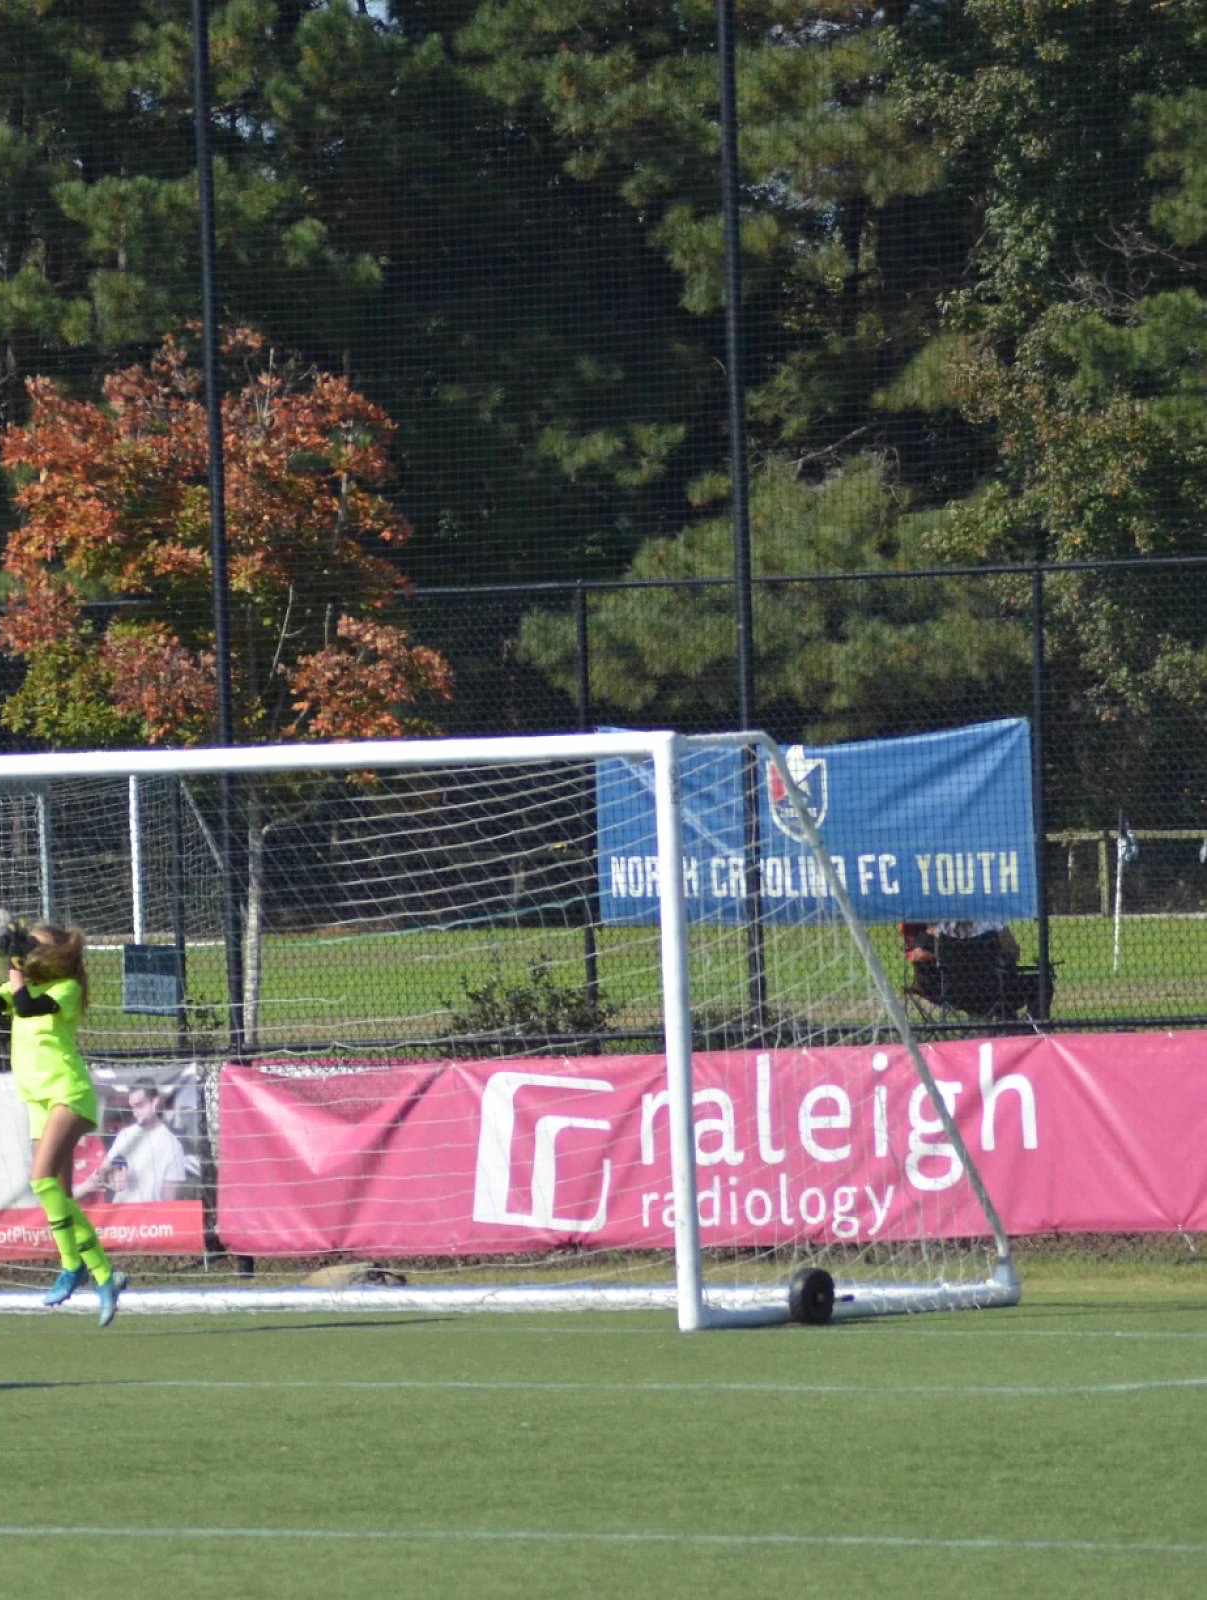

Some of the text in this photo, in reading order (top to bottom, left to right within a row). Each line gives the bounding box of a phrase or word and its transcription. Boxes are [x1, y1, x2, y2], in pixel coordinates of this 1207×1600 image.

[610, 850, 1020, 898] NORH CAOLINA FC YOUTH
[640, 1043, 1037, 1192] raleigh
[641, 1174, 895, 1239] radiology
